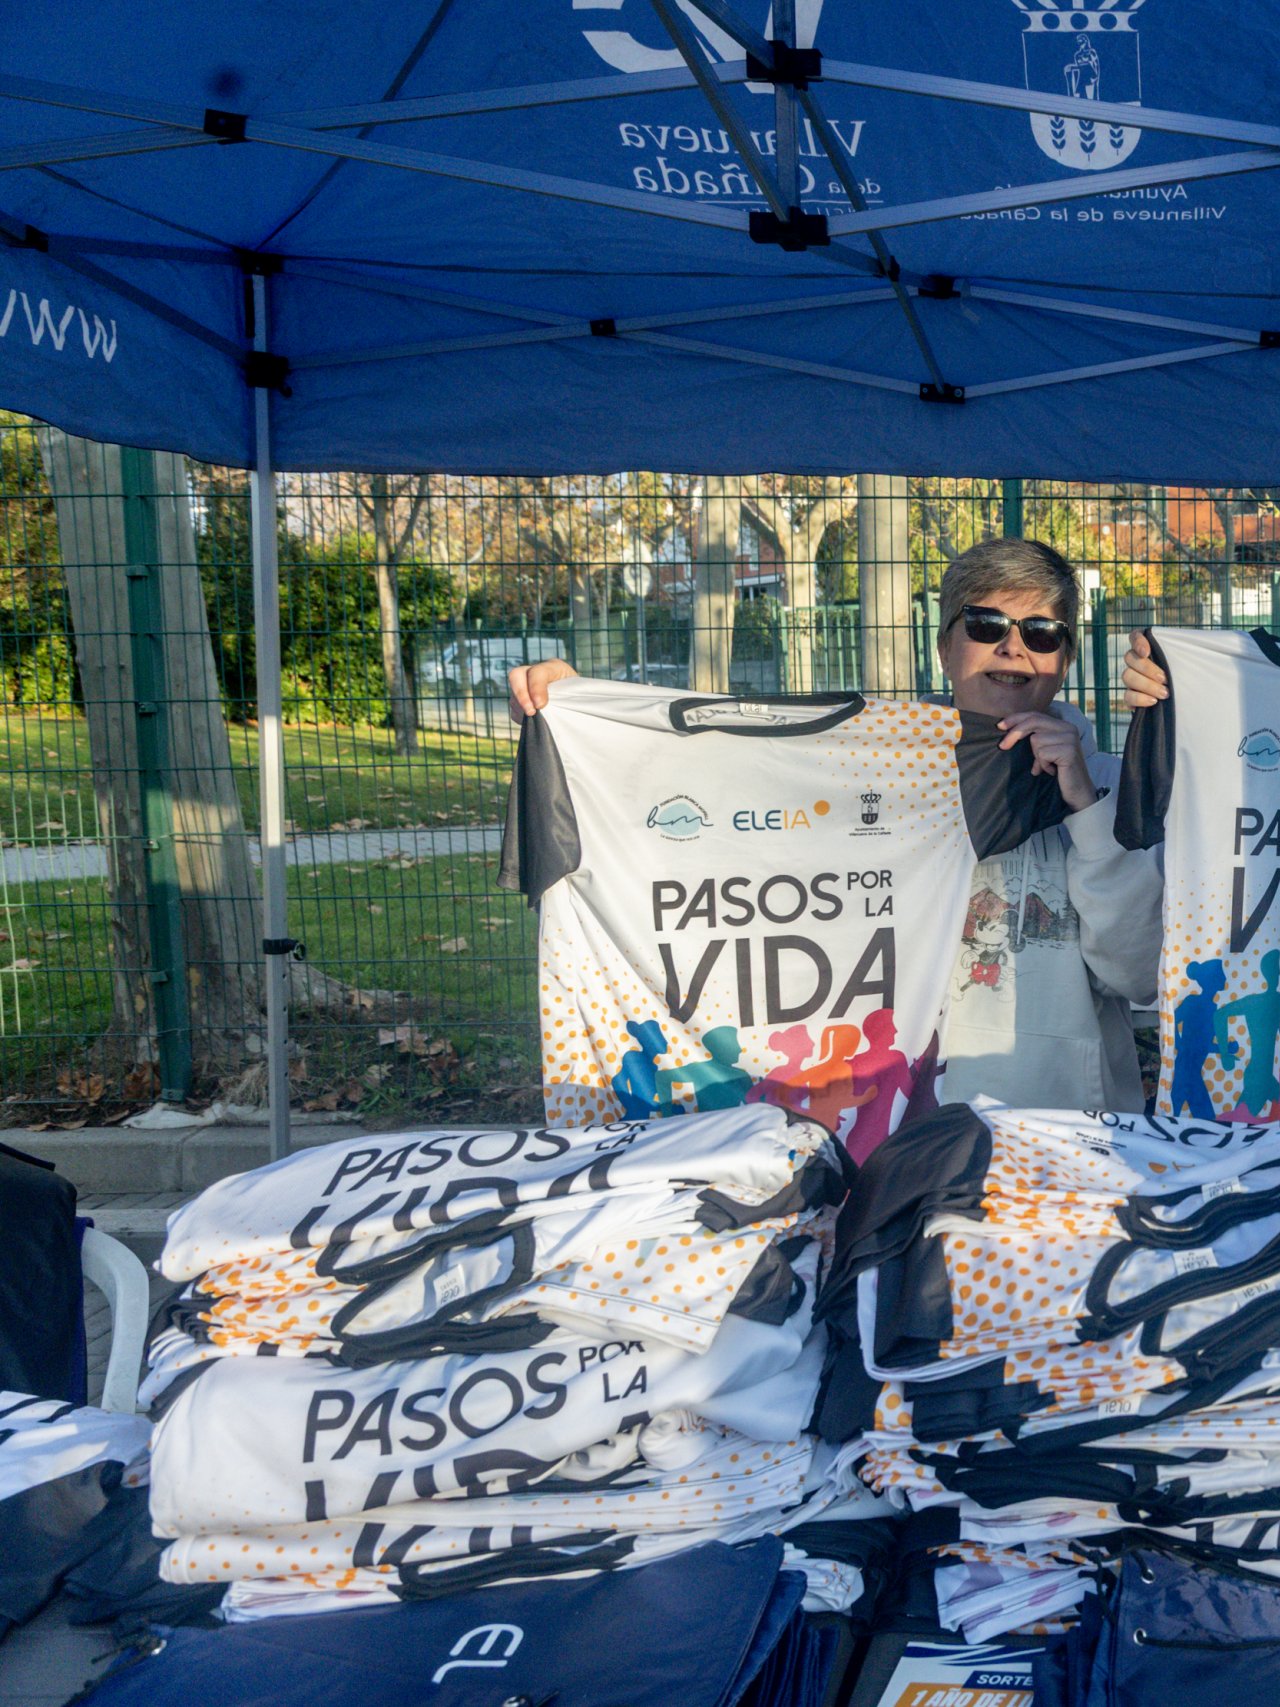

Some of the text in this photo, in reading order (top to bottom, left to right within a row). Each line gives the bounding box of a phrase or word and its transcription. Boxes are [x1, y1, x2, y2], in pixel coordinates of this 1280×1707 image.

[732, 809, 811, 832] ELEIA
[652, 869, 893, 932] PASOS POR
[865, 895, 894, 917] LA
[657, 926, 896, 1028] VIDA
[594, 1132, 639, 1152] LA
[321, 1129, 571, 1197] PASOS
[602, 1365, 648, 1403] LA
[302, 1352, 568, 1463] PASOS
[976, 1673, 1033, 1687] SORTE
[910, 1689, 928, 1707] 1
[925, 1687, 974, 1707] AÑO
[973, 1692, 1009, 1707] DE
